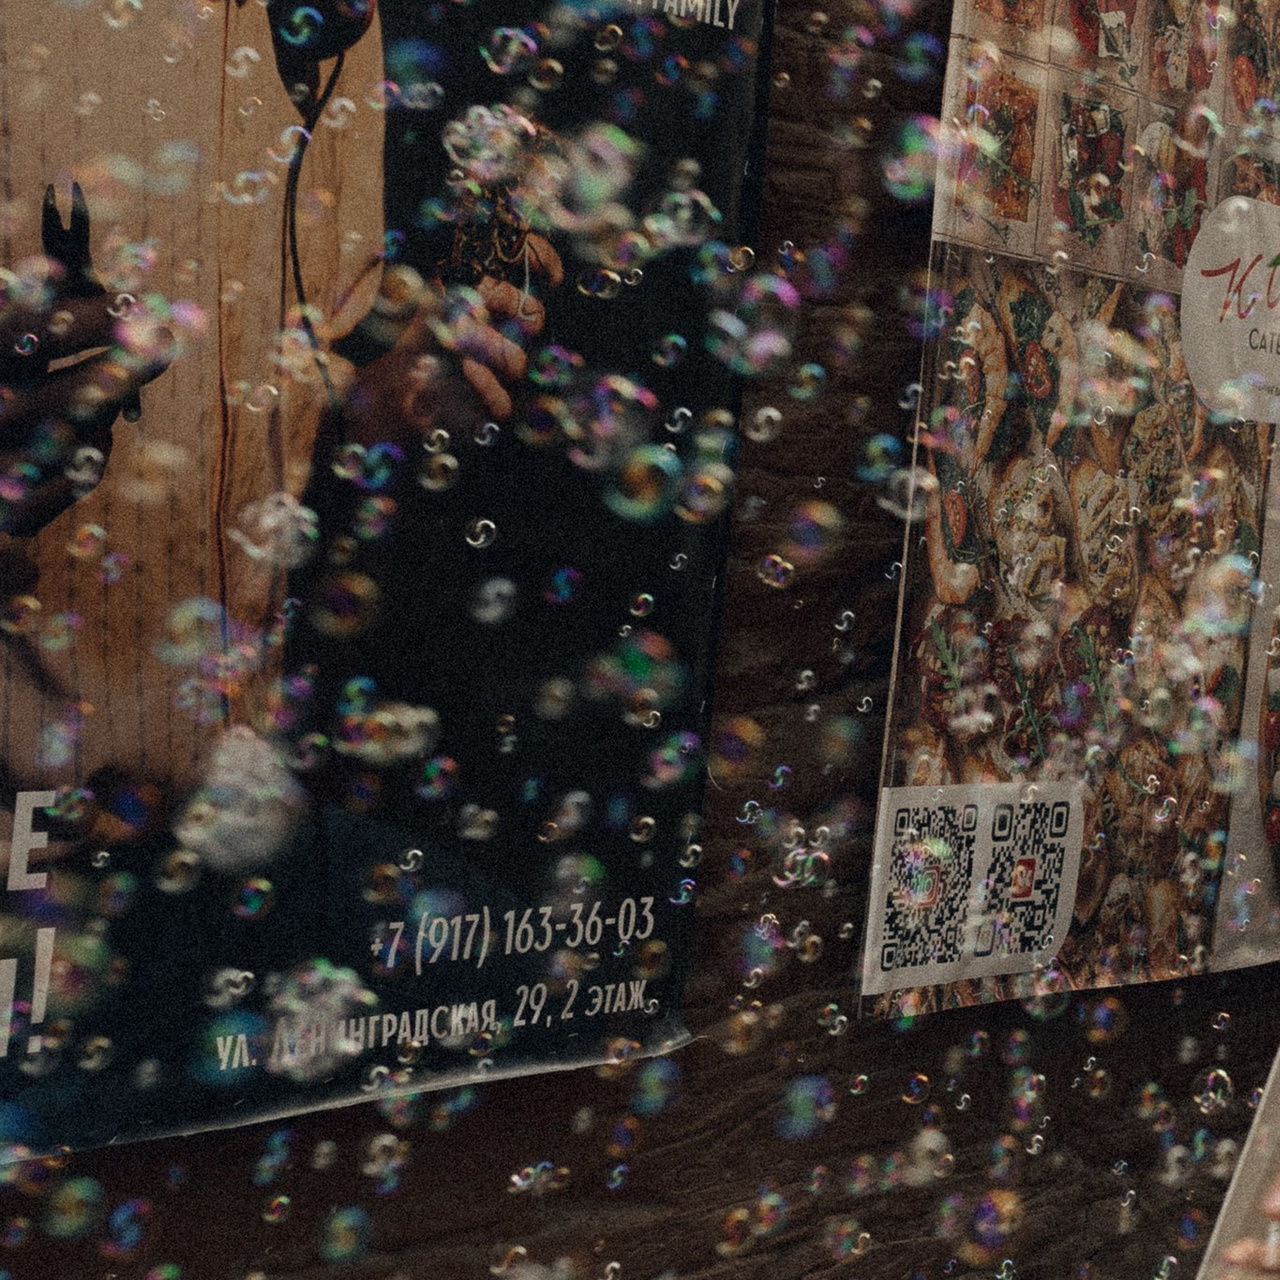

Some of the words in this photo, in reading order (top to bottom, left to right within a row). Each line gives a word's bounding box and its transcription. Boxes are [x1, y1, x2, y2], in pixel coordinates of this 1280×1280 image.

[370, 921, 404, 969] +7
[414, 905, 491, 976] (917)
[503, 897, 656, 955] 163-36-03
[216, 1035, 257, 1071] УЛ.
[513, 983, 553, 1028] 29,
[561, 980, 576, 1020] 2
